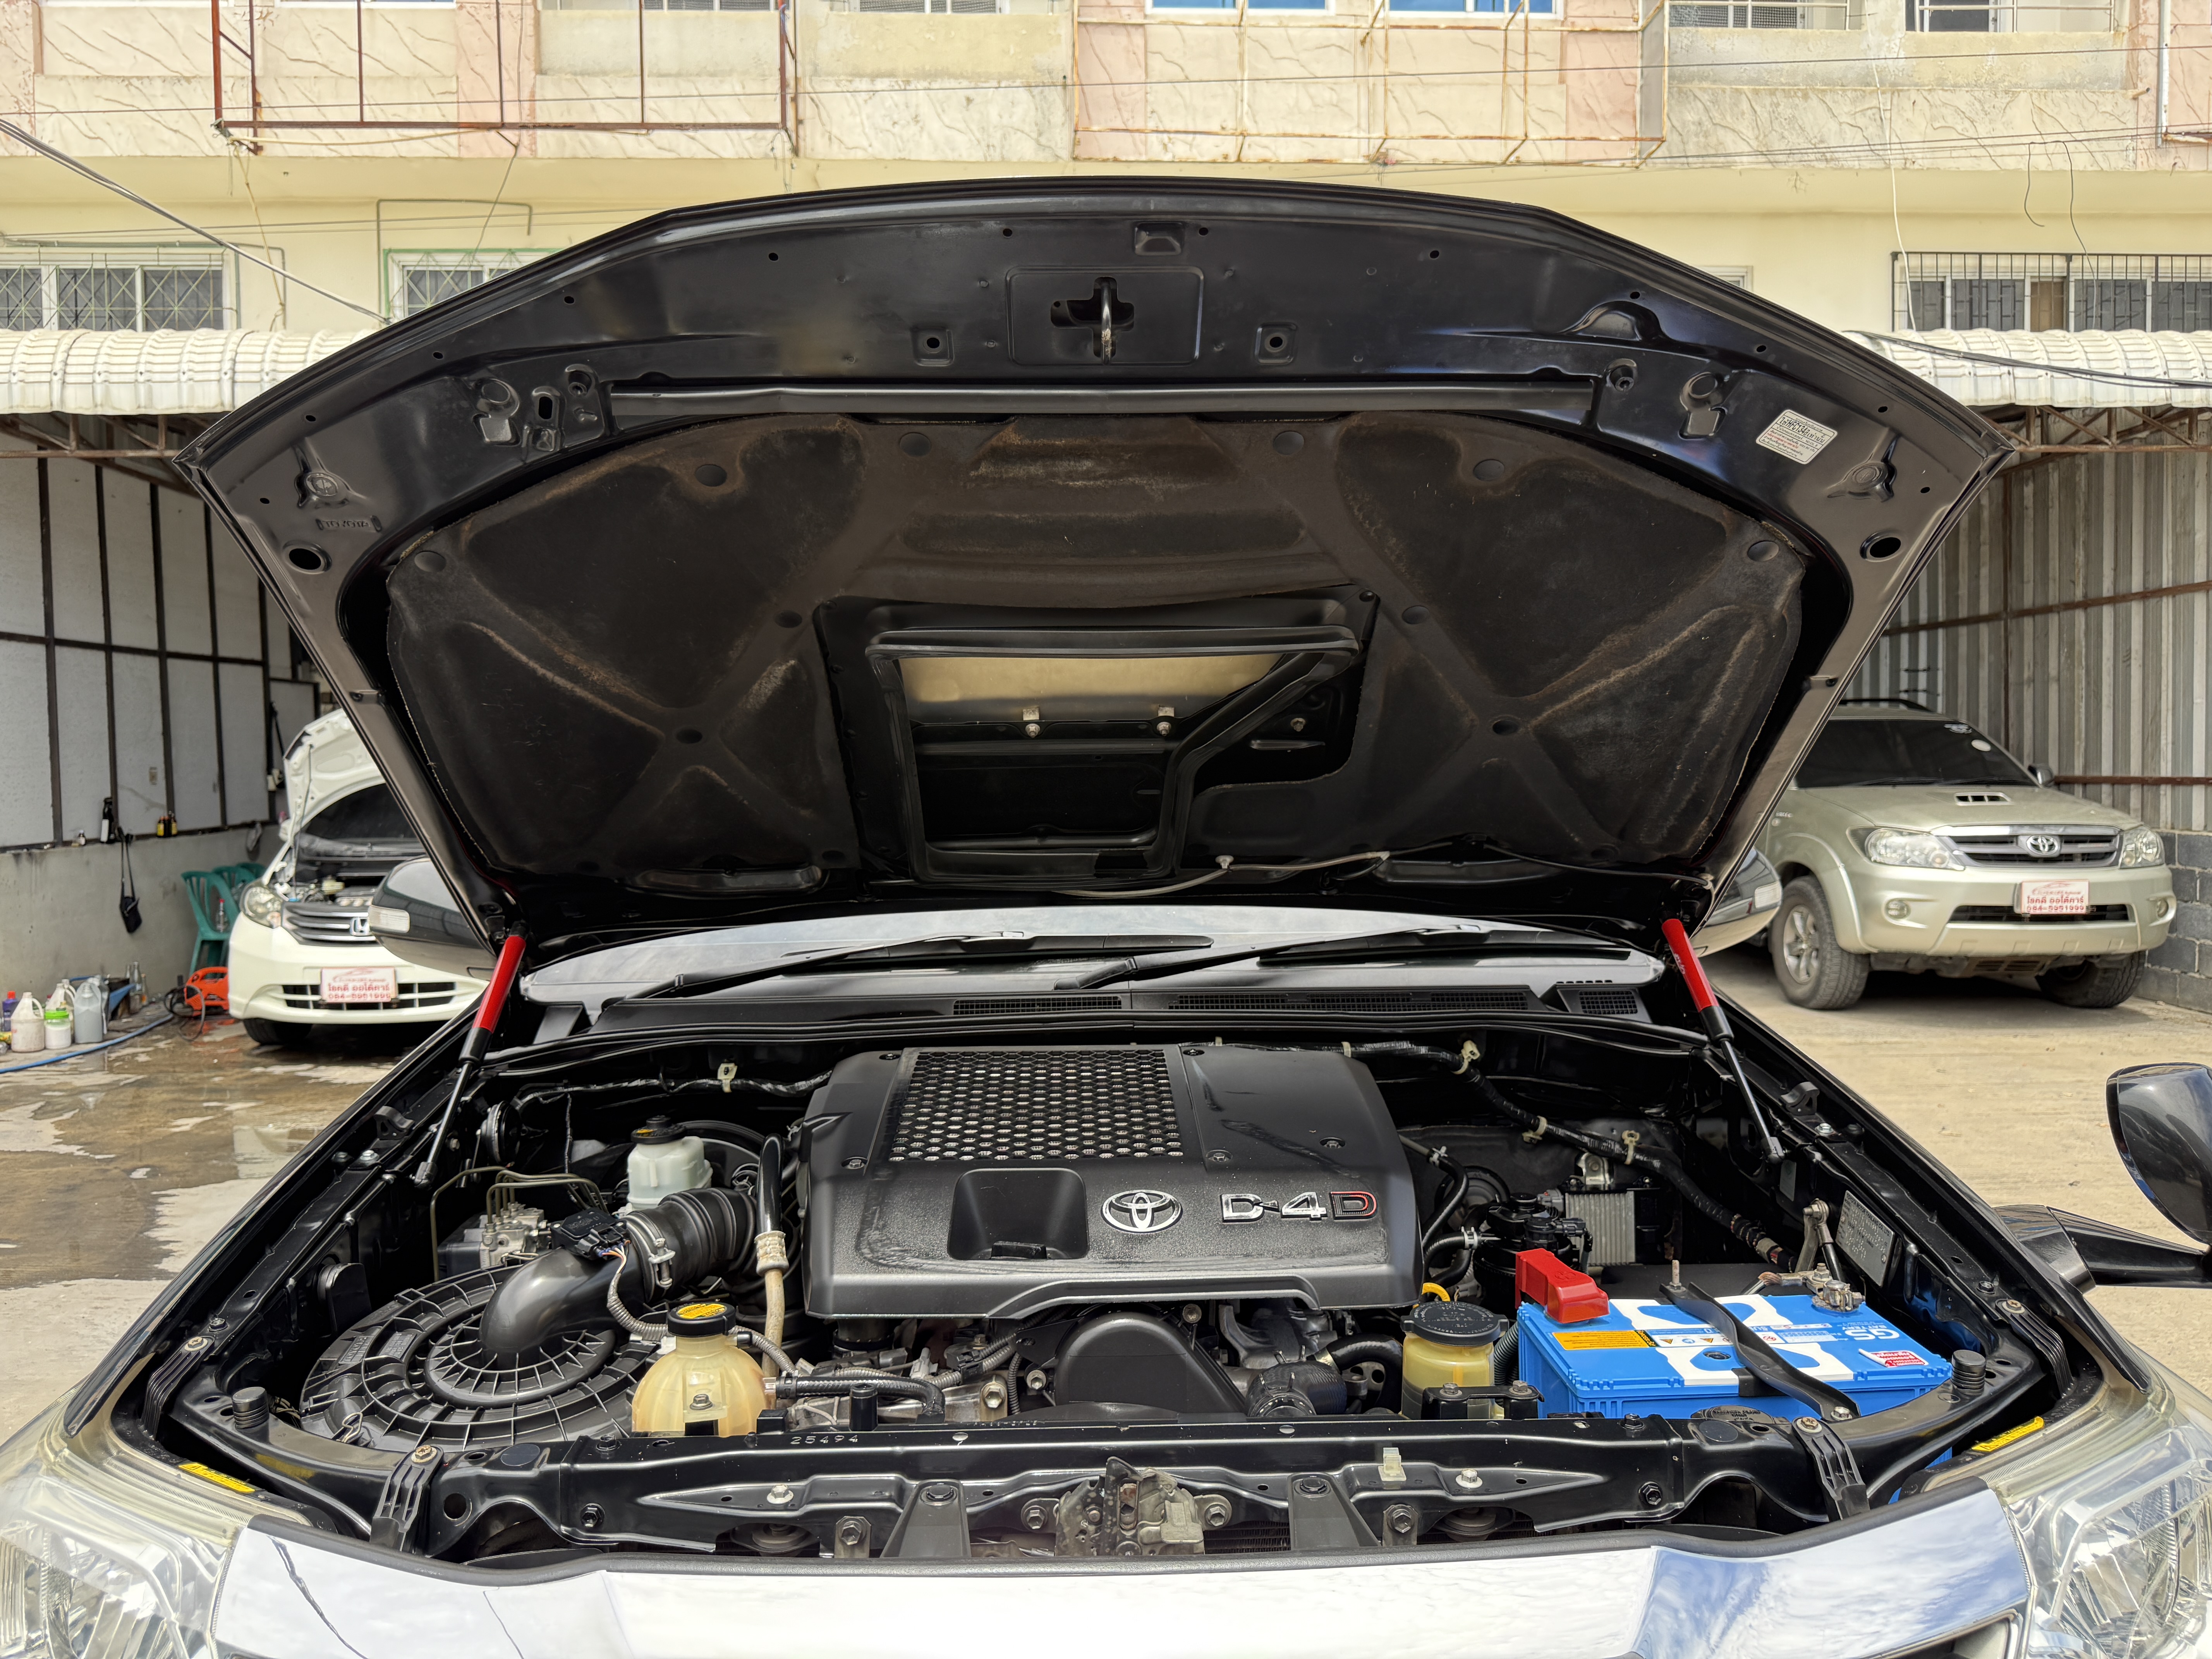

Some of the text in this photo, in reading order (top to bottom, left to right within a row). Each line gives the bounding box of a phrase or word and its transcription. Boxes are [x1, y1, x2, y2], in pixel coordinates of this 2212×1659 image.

[323, 519, 371, 528] TOYOTA
[1220, 1191, 1377, 1222] D-4D
[1846, 1193, 1856, 1205] TOYOTA
[1856, 1202, 1866, 1214] MOTOR
[1844, 1328, 1900, 1340] GS
[790, 1435, 859, 1444] 25494
